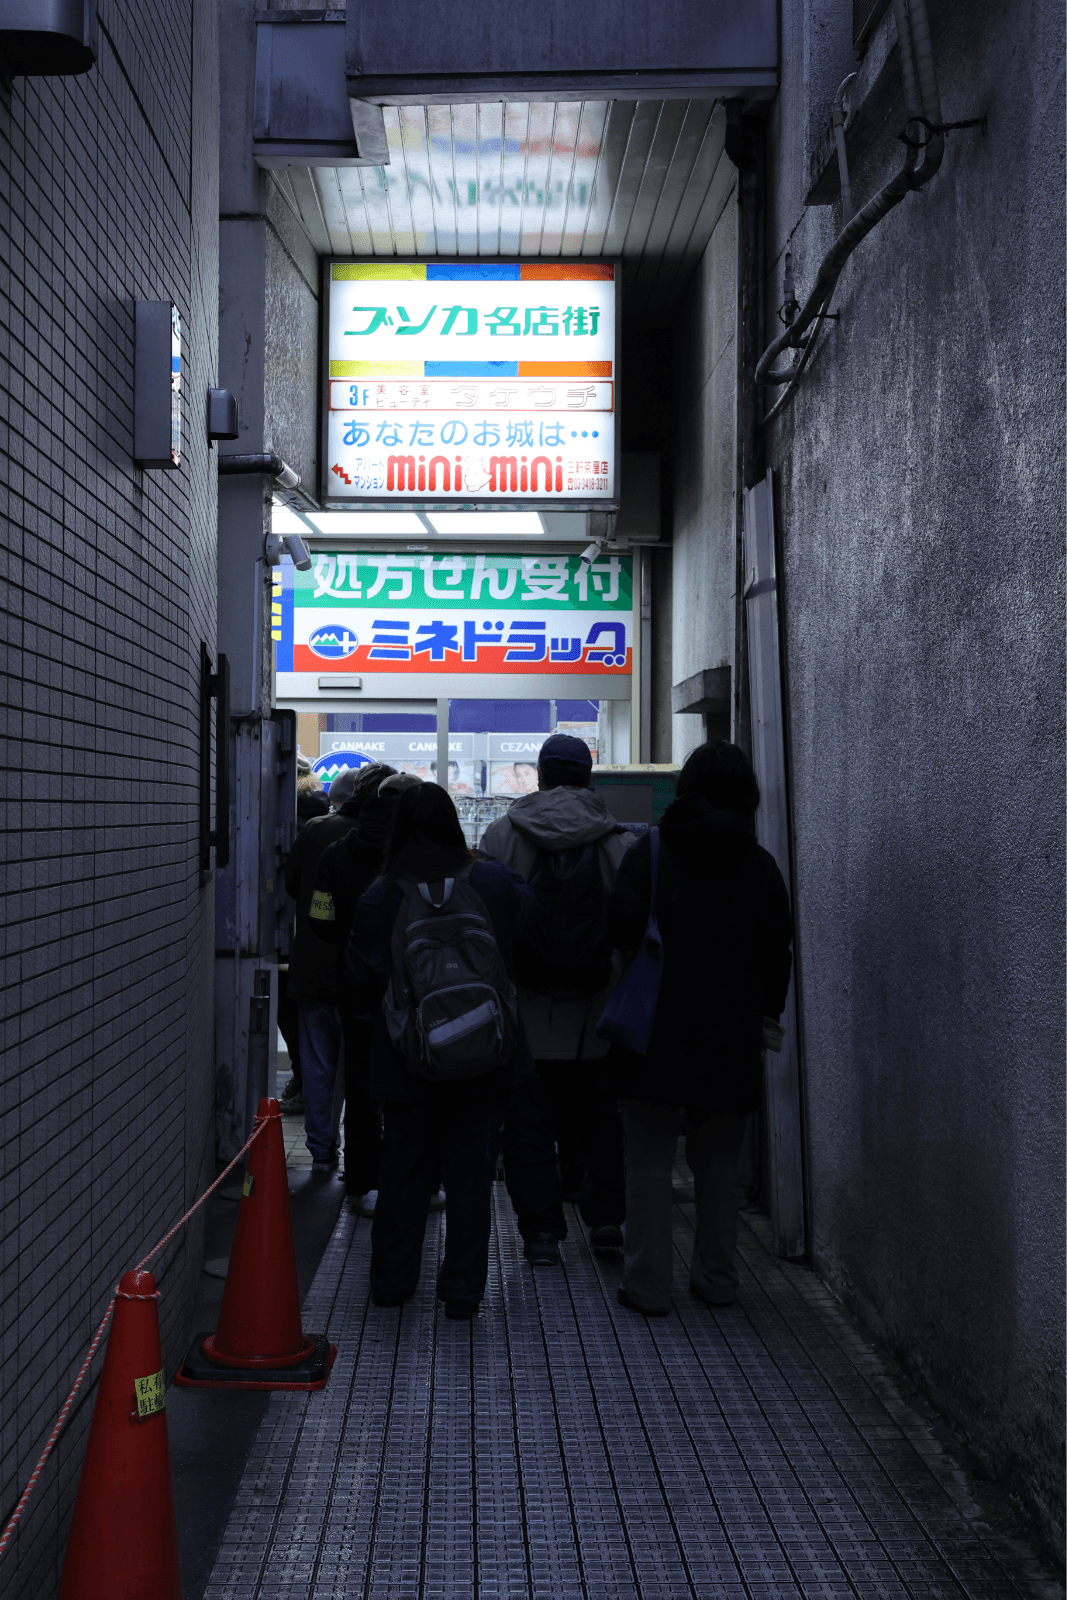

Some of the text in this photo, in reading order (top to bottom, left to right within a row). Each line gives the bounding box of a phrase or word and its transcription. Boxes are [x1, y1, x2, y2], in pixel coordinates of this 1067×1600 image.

[349, 384, 370, 406] 3F
[376, 384, 430, 396] 美容室
[450, 385, 597, 408] タケウチ
[355, 457, 385, 472] アパート
[386, 455, 563, 492] mini mini
[353, 475, 385, 489] マンション
[312, 553, 622, 602] 処方せん受付
[331, 741, 463, 752] CANMAKE CANMKE
